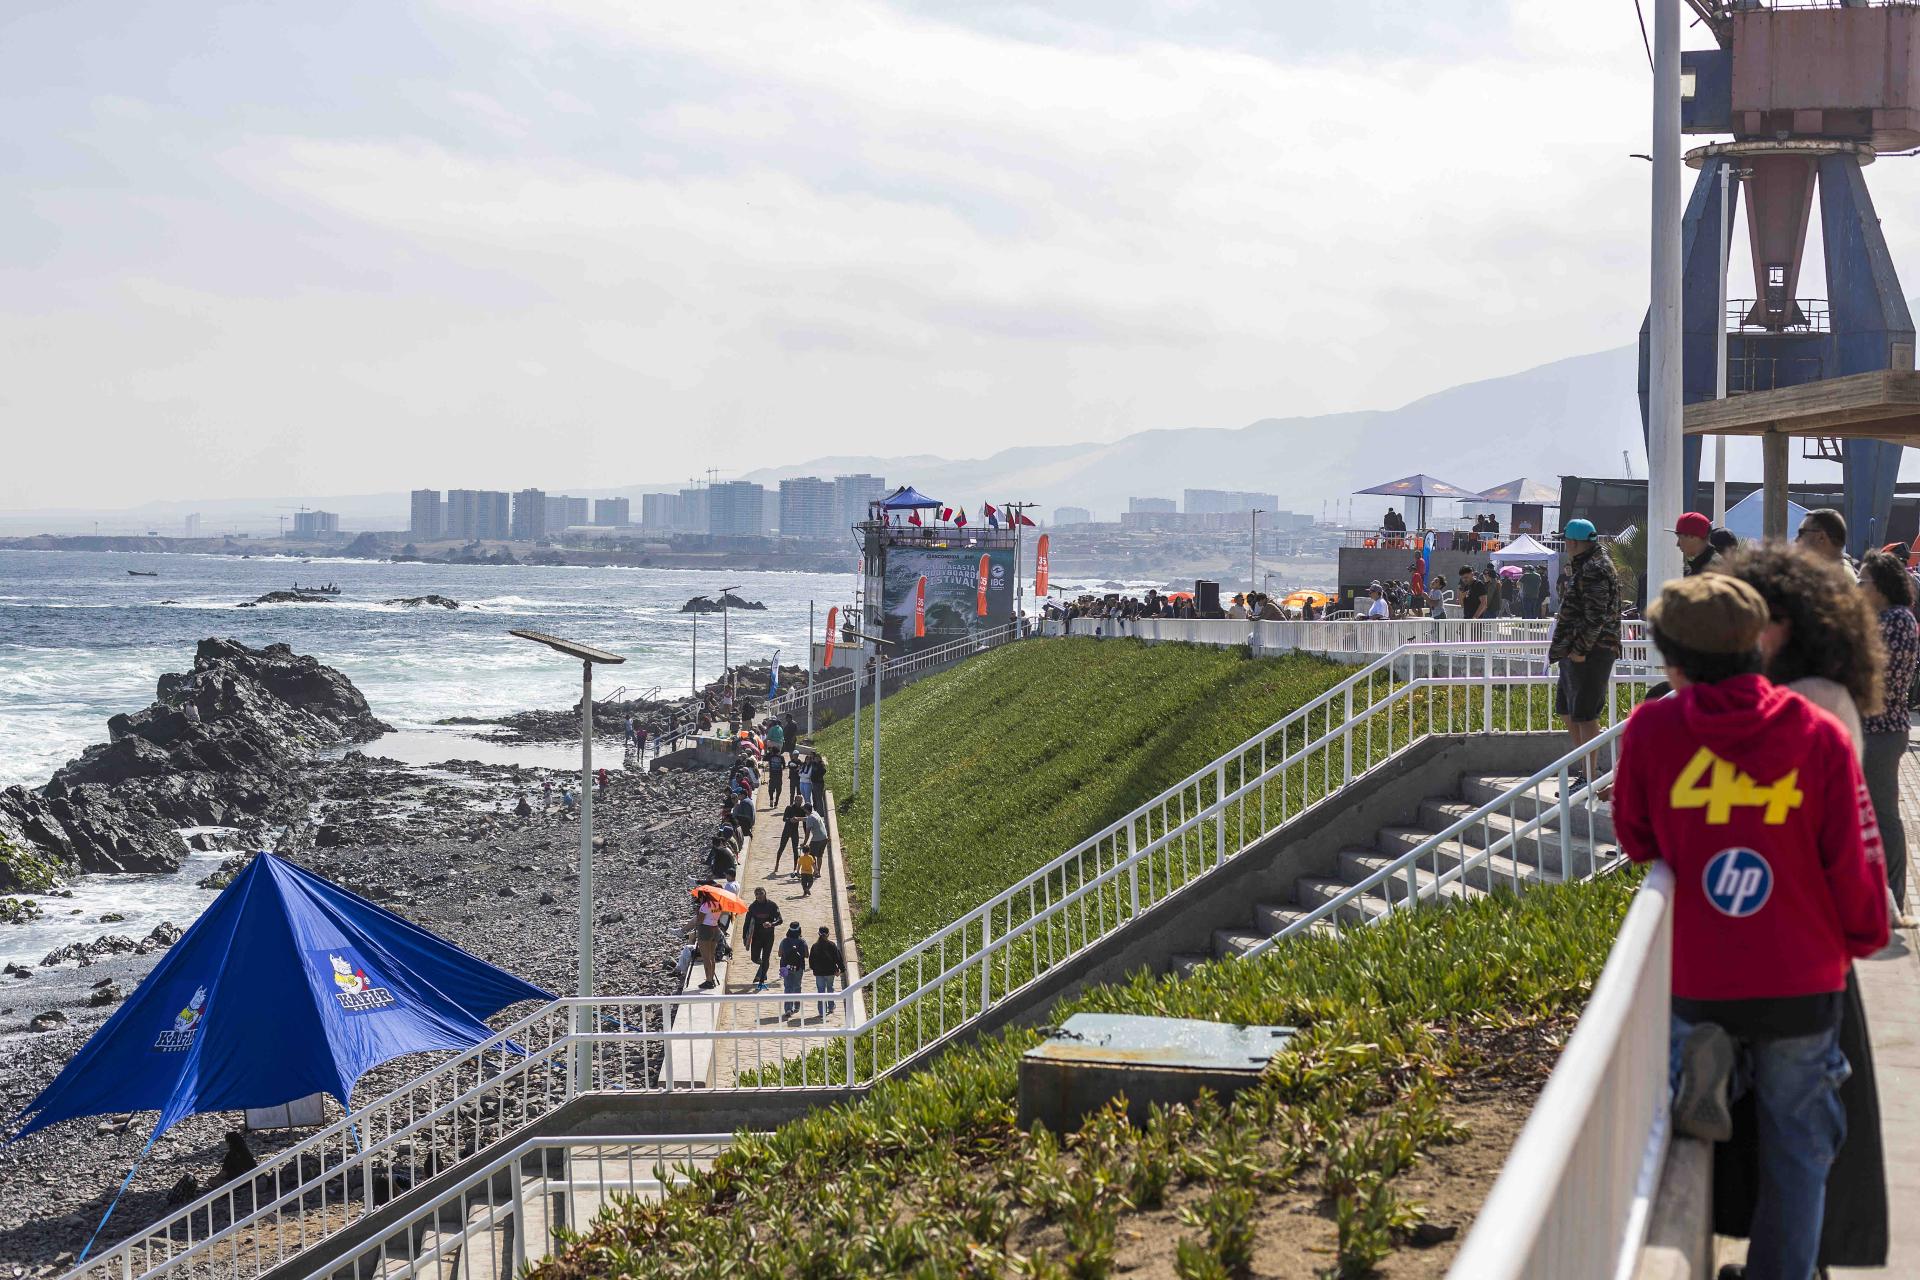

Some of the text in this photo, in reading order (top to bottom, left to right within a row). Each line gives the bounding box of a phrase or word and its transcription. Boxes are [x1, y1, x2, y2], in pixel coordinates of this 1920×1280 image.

[1038, 556, 1047, 565] 35
[927, 575, 976, 588] ESTIVAL
[990, 579, 1005, 587] IBC
[1670, 745, 1804, 825] 44
[1713, 849, 1763, 916] hp
[335, 987, 394, 1009] KAFIR
